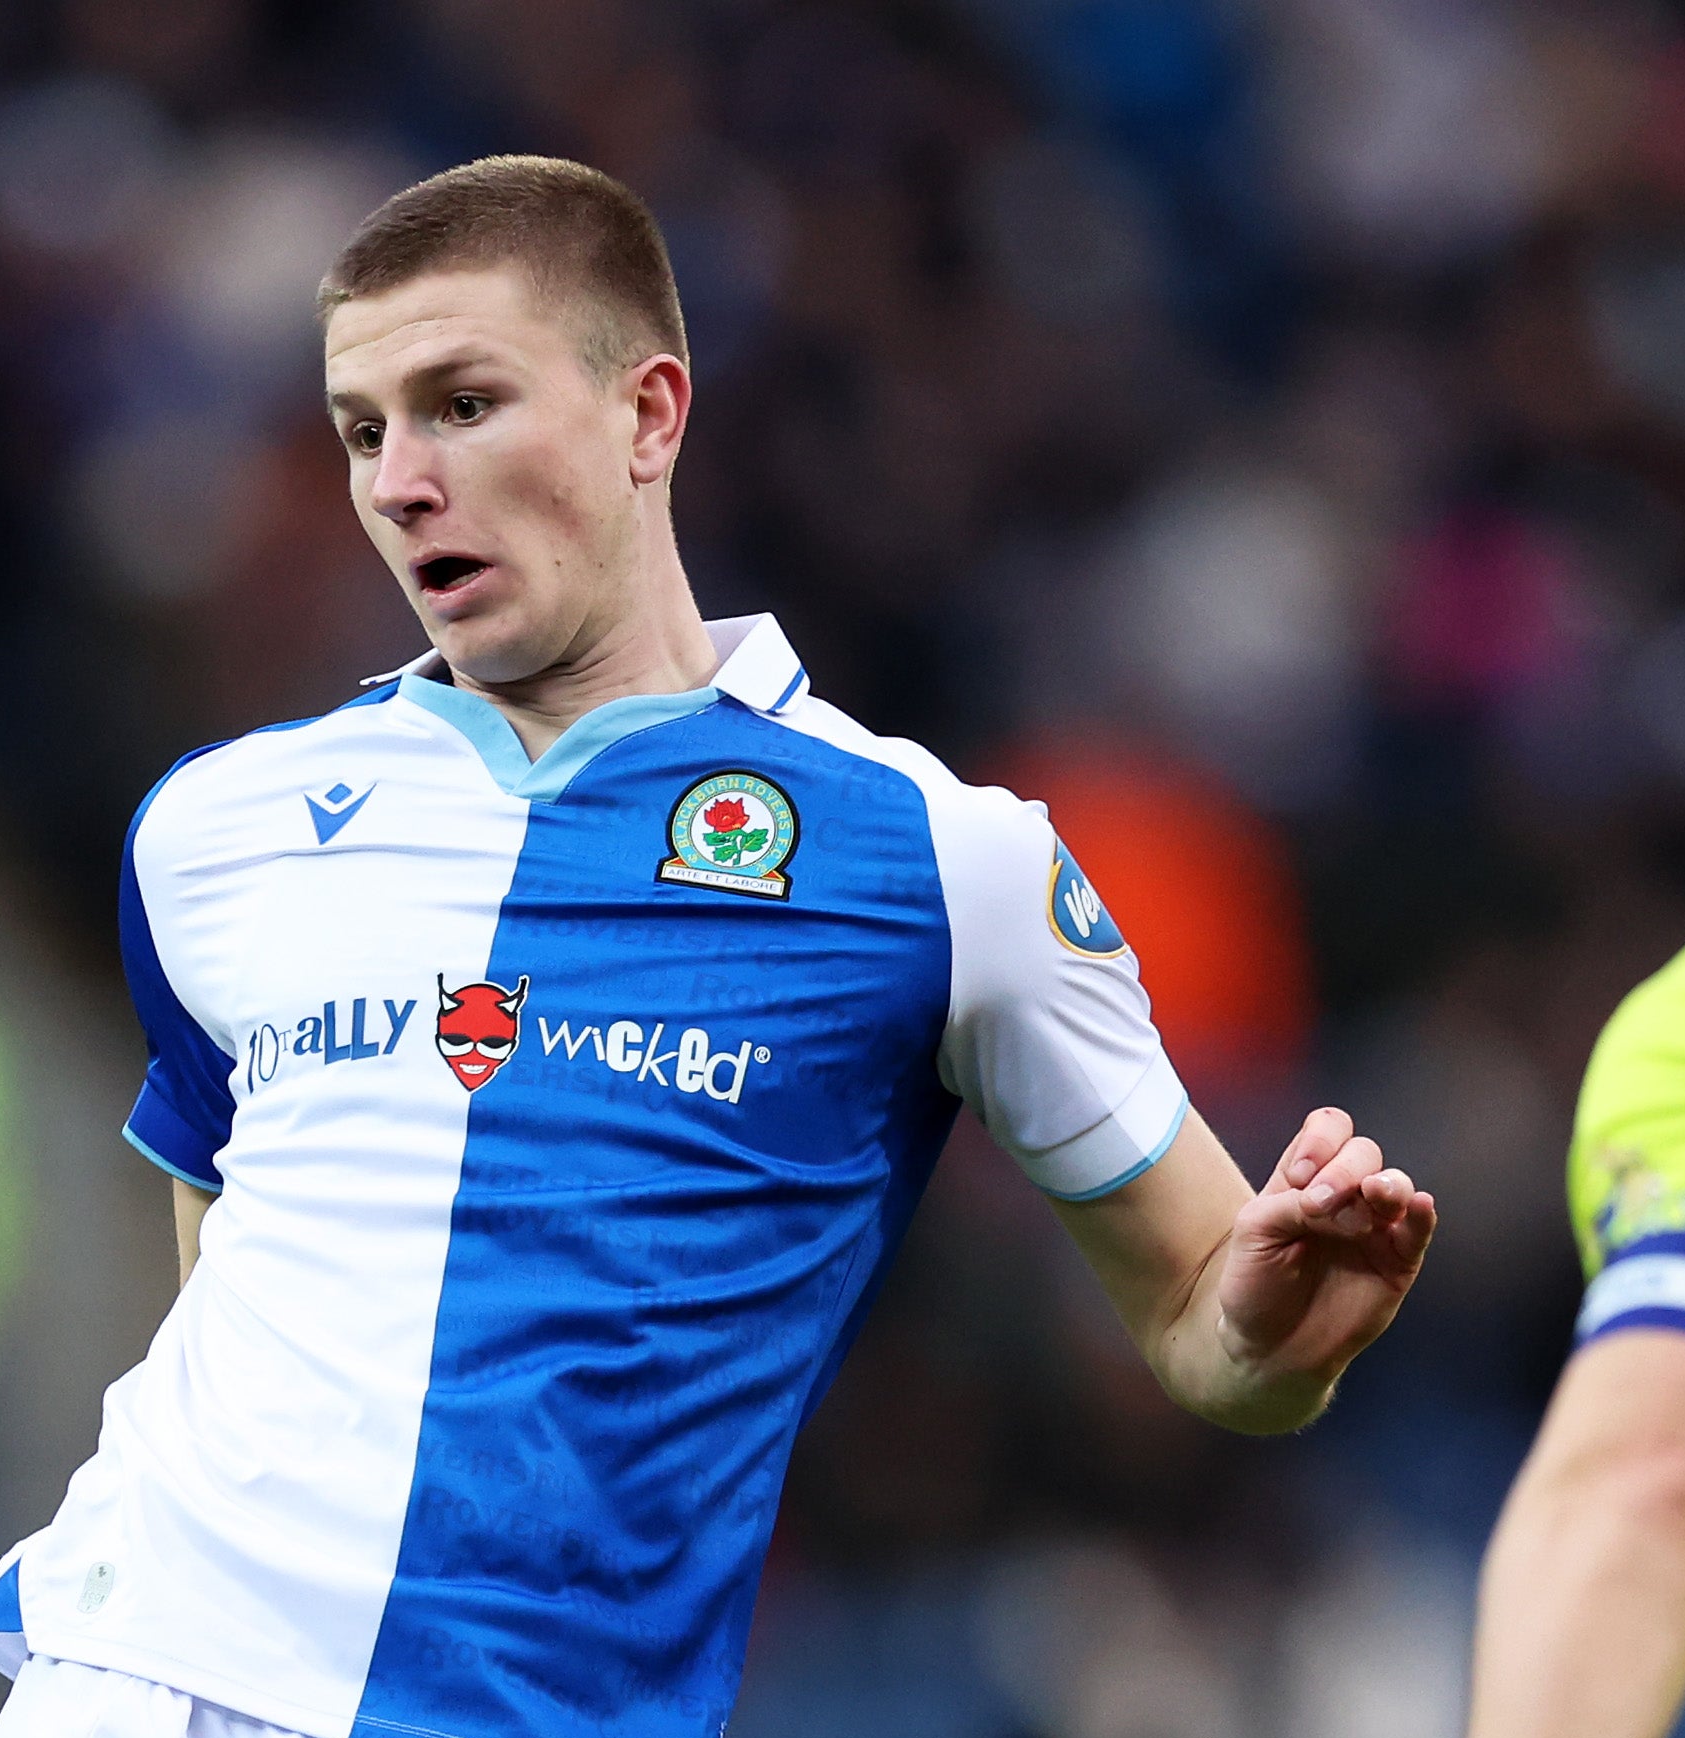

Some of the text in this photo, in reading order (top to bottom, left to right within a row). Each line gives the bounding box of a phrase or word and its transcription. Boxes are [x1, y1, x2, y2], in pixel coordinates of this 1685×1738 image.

[676, 776, 739, 848] BLACKBURN
[744, 777, 791, 830] ROVERS
[668, 868, 778, 892] ARTE ET LABORE
